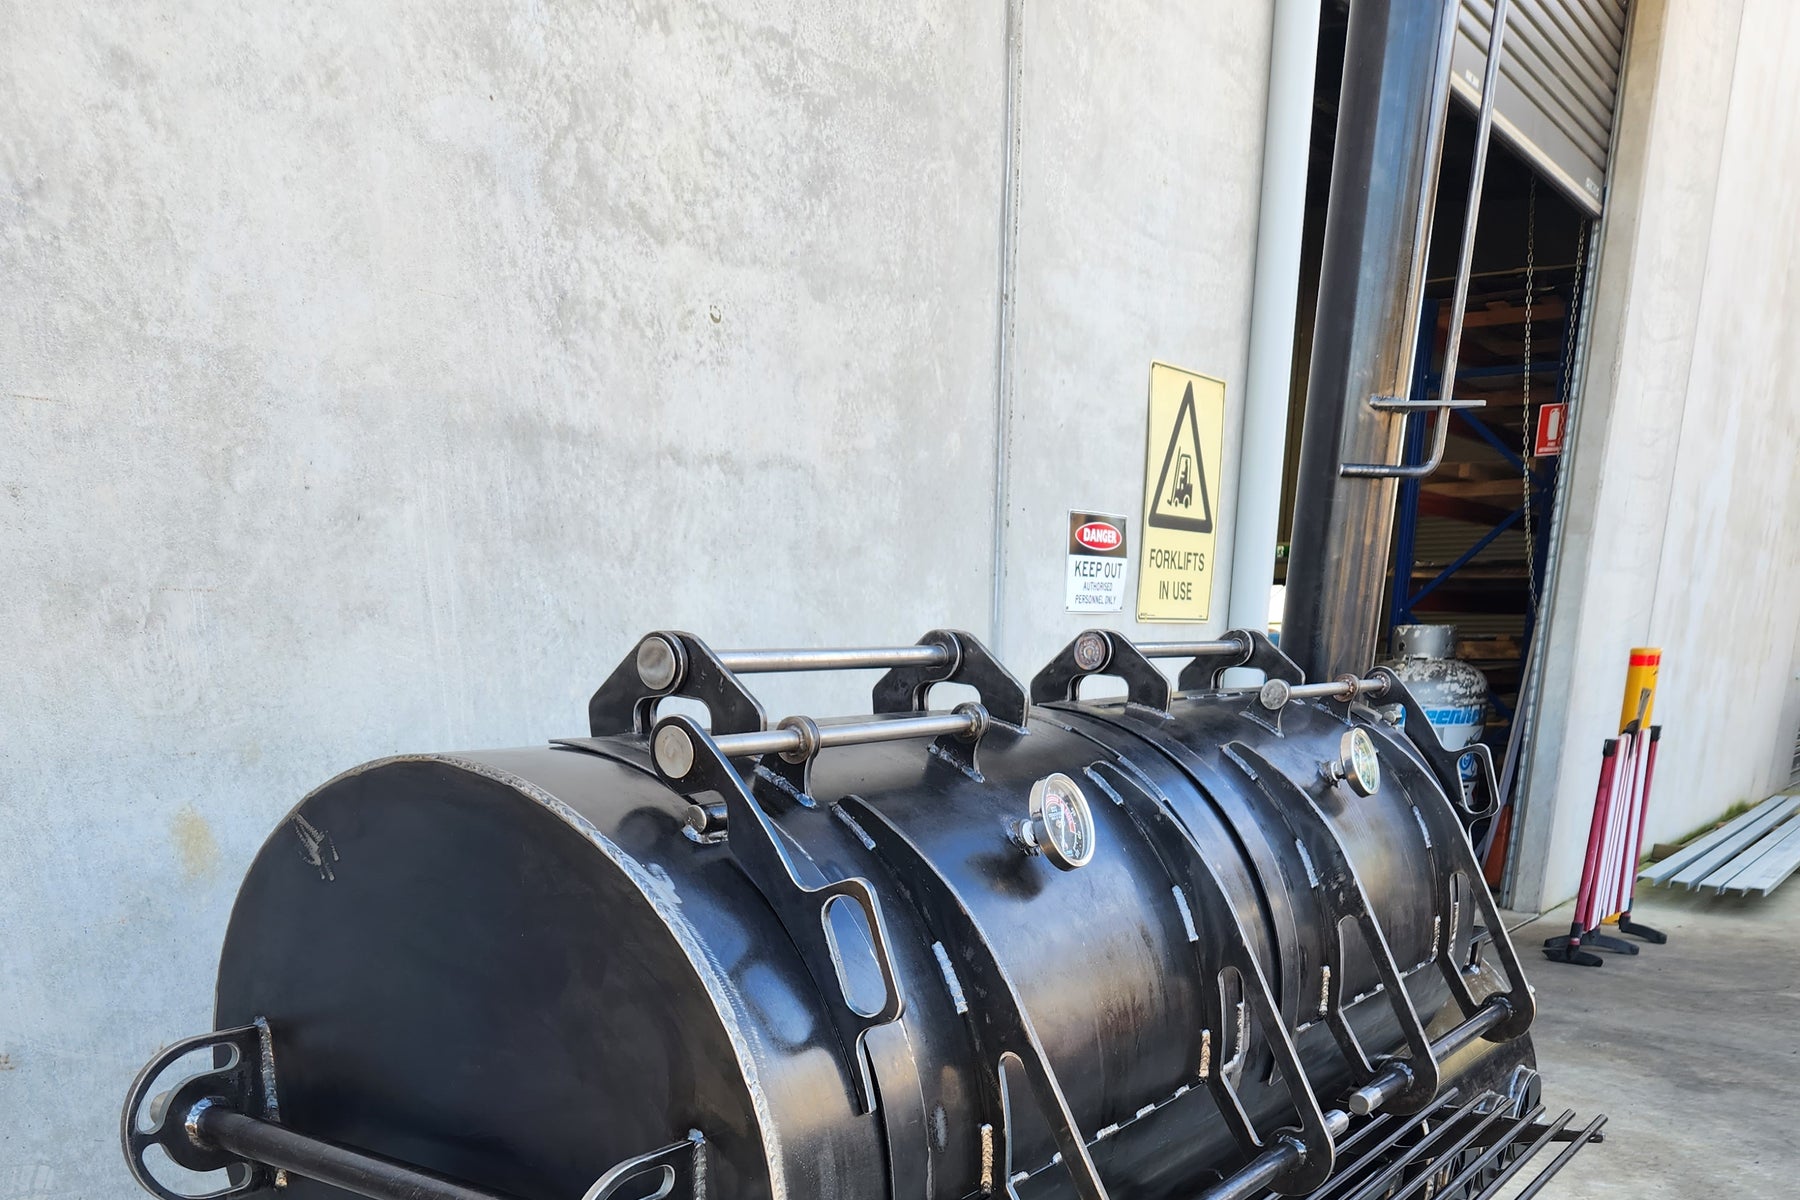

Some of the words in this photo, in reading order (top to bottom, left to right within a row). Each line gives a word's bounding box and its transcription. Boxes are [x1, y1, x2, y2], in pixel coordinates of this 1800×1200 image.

[1083, 527, 1117, 544] DANGER
[1074, 560, 1102, 578] KEEP
[1104, 562, 1123, 579] OUT
[1149, 548, 1205, 572] FORKLIFTS
[1074, 594, 1104, 605] PERSONNEL
[1104, 595, 1117, 605] ONLY
[1159, 580, 1170, 600] IN
[1172, 581, 1193, 601] USE
